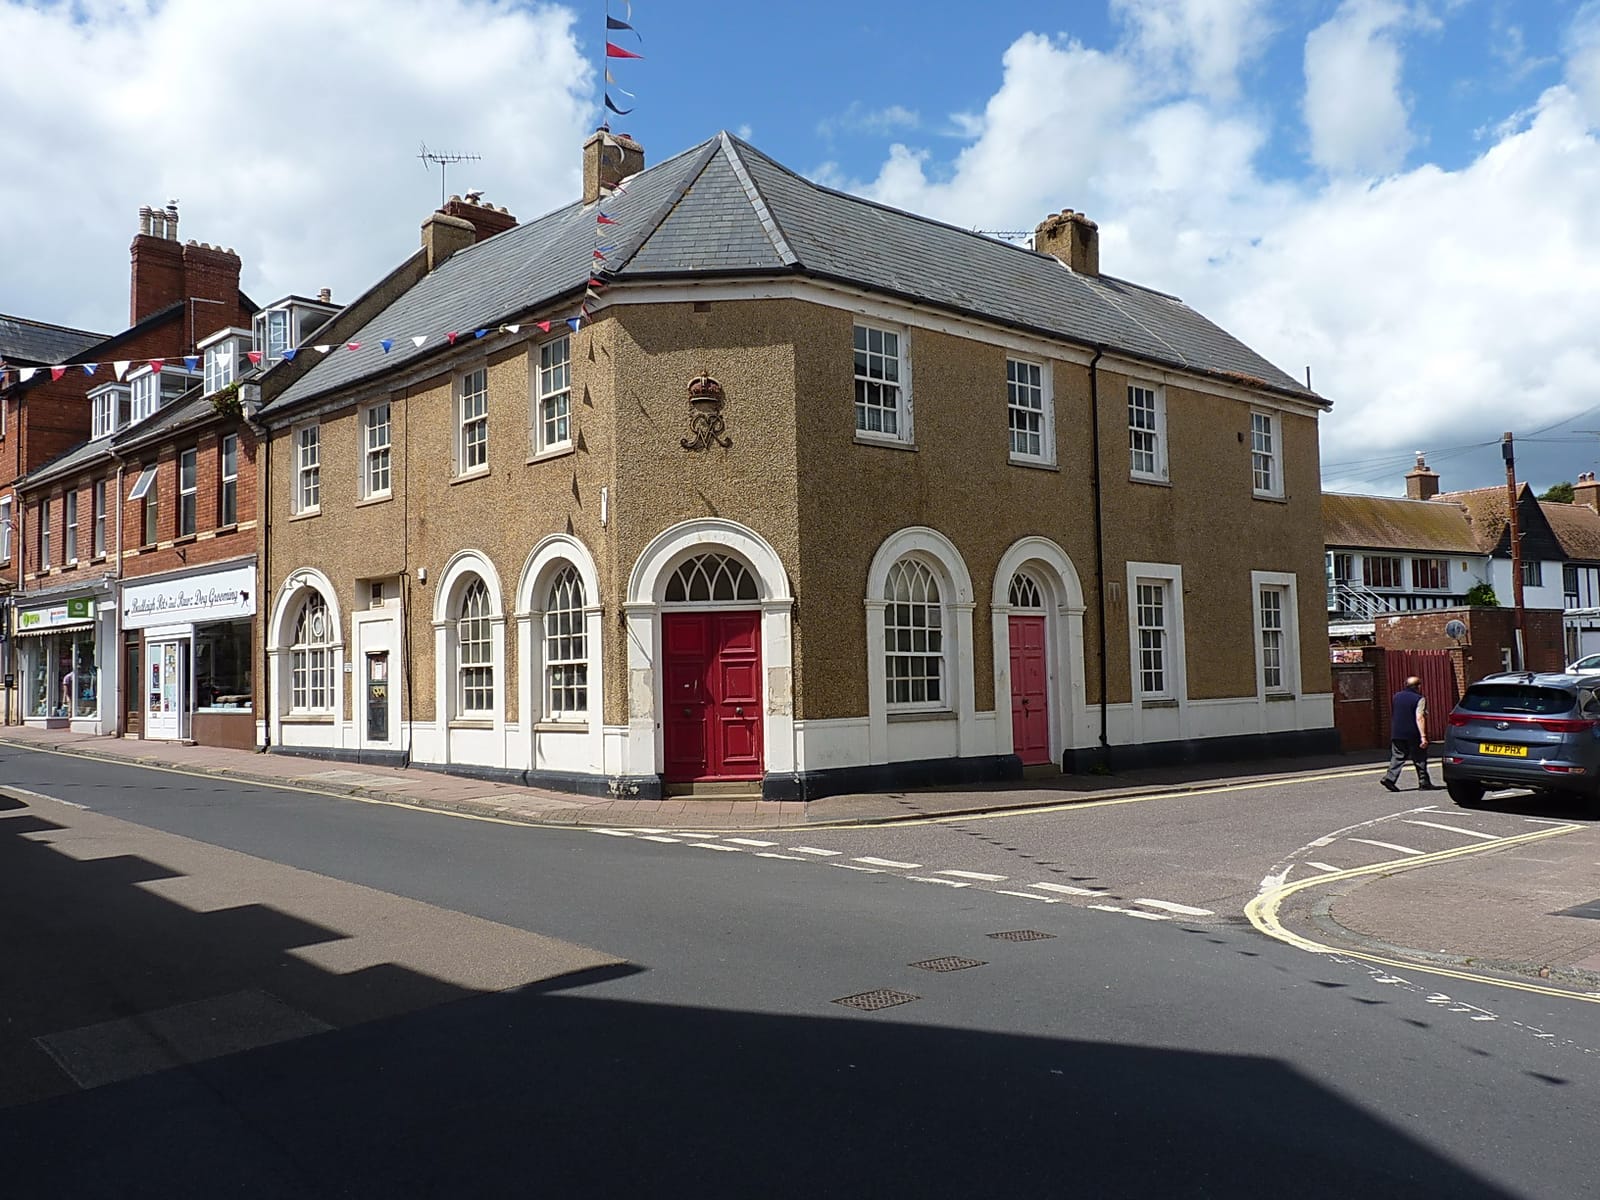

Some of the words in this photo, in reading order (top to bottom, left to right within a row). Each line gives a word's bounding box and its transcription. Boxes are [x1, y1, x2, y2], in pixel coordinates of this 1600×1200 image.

[194, 588, 208, 609] Dog
[208, 587, 238, 608] Grooming
[1504, 744, 1521, 754] PHX
